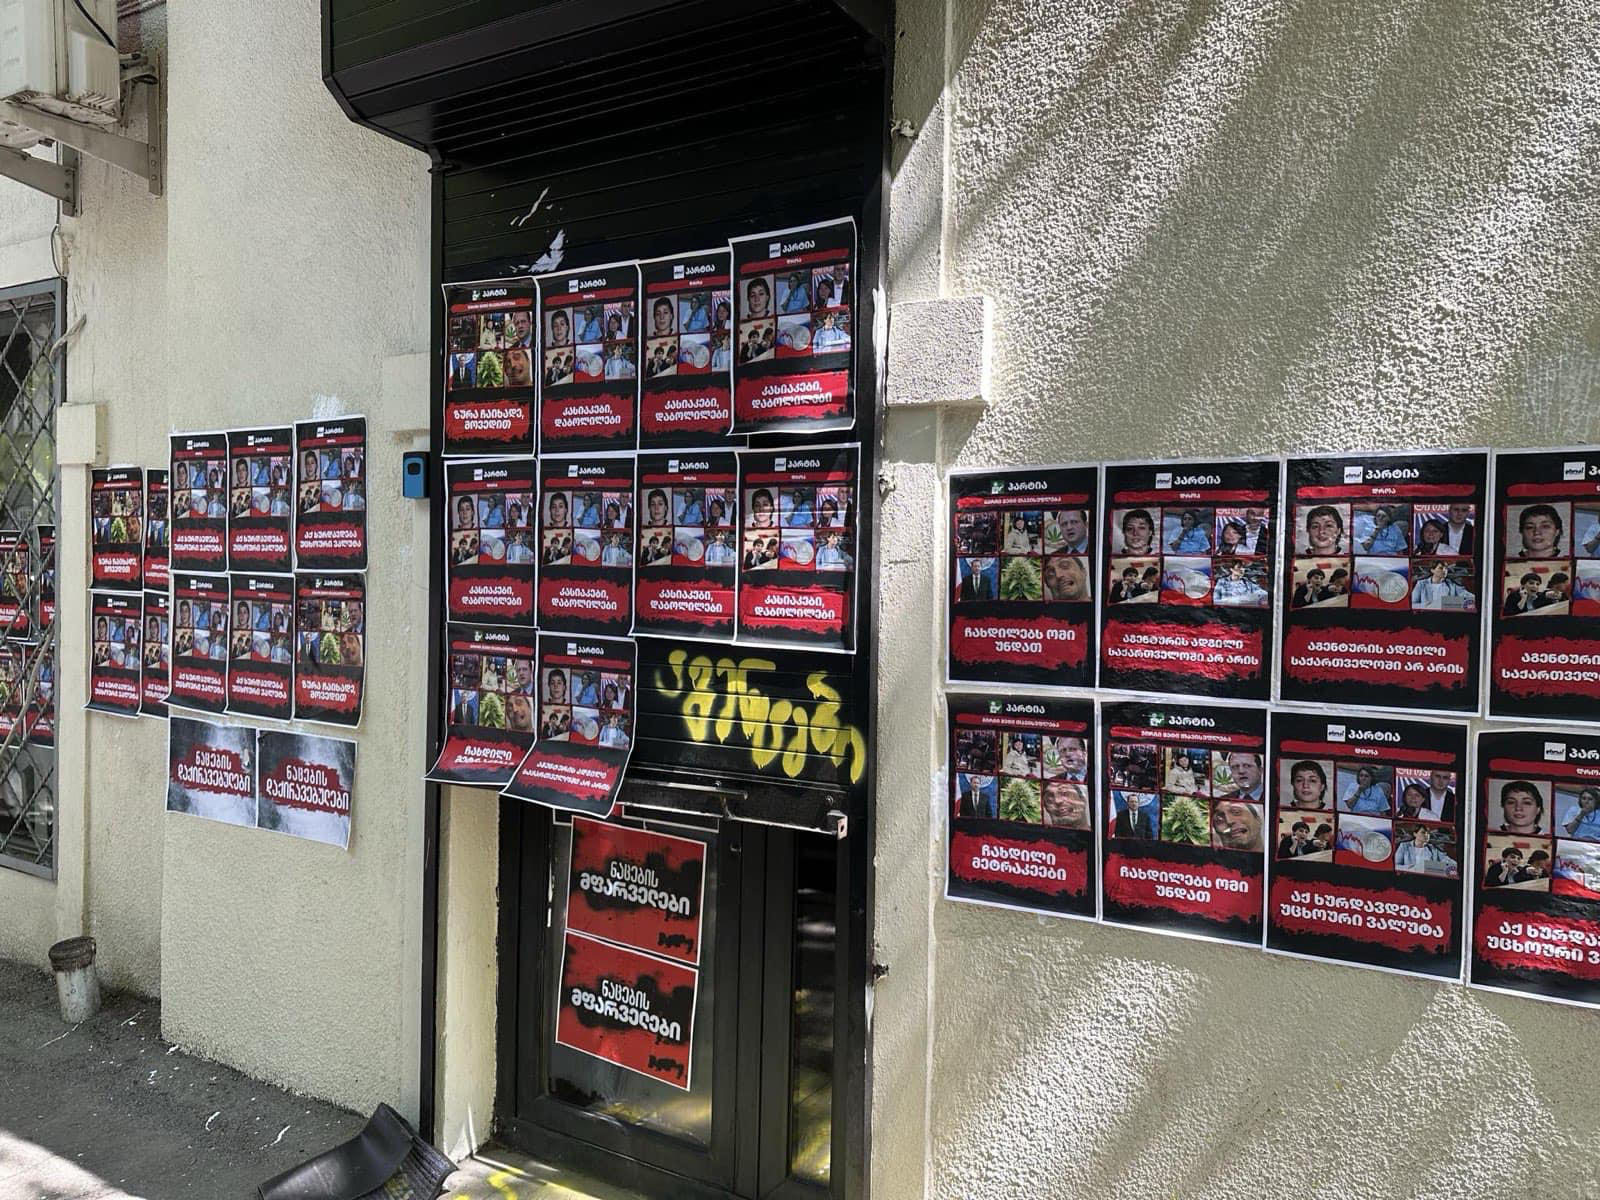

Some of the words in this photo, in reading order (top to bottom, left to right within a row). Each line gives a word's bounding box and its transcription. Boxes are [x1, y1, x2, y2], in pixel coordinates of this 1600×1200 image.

[782, 240, 815, 253] პარტია
[685, 264, 715, 275] პარტია
[762, 380, 823, 396] კასიაკები,
[664, 398, 719, 410] კასიაკები,
[554, 415, 621, 427] დაბოლილები
[655, 409, 729, 422] დაბოლილები
[680, 462, 709, 470] პარტია
[787, 459, 820, 468] პარტია
[1174, 475, 1221, 485] პარტია
[1365, 468, 1419, 479] პარტია
[1008, 481, 1048, 491] პარტია
[559, 587, 609, 600] კასიაკები,
[659, 589, 713, 602] კასიაკები,
[461, 596, 522, 606] დაბოლილები
[551, 598, 617, 610] დაბოლილები
[650, 600, 723, 613] დაბოლილები
[764, 595, 825, 608] კასიაკები,
[754, 606, 835, 619] დაბოლილები
[964, 627, 1044, 640] ჩახდილებს
[1046, 629, 1075, 640] ომი
[995, 641, 1042, 653] უნდათ
[1123, 634, 1189, 646] აგენტურის
[1190, 638, 1243, 649] ადგილი
[1308, 642, 1384, 654] აგენტურის
[1386, 645, 1446, 656] ადგილი
[1108, 648, 1206, 662] საქართველოში
[1206, 653, 1224, 663] არ
[1226, 654, 1259, 665] არის
[1291, 656, 1401, 671] საქართველოში
[1404, 662, 1424, 671] არ
[1427, 663, 1464, 674] არის
[1006, 704, 1045, 714] პარტია
[1168, 715, 1215, 727] პარტია
[1348, 729, 1401, 742] პარტია
[464, 746, 512, 760] ჩახდილი
[195, 750, 232, 770] ნაცების
[177, 763, 251, 793] დაქირავებულები
[286, 765, 327, 786] ნაცების
[265, 778, 350, 811] დაქირავებულები
[981, 844, 1056, 865] ჩახდილი
[608, 861, 659, 888] ნაცების
[972, 857, 1066, 880] მეტრაკეები
[1120, 867, 1212, 888] ჩახდილებს
[1215, 878, 1248, 893] ომი
[580, 872, 690, 915] მფარველები
[1155, 885, 1211, 903] უნდათ
[1291, 890, 1311, 904] აქ
[1313, 893, 1432, 920] ხურდავდება
[1280, 903, 1363, 926] უცხოური
[1366, 916, 1444, 938] ვალუტა
[1499, 921, 1523, 936] აქ
[1487, 935, 1583, 961] უცხოური
[600, 979, 650, 1010] ნაცების
[571, 988, 681, 1041] მფარველები
